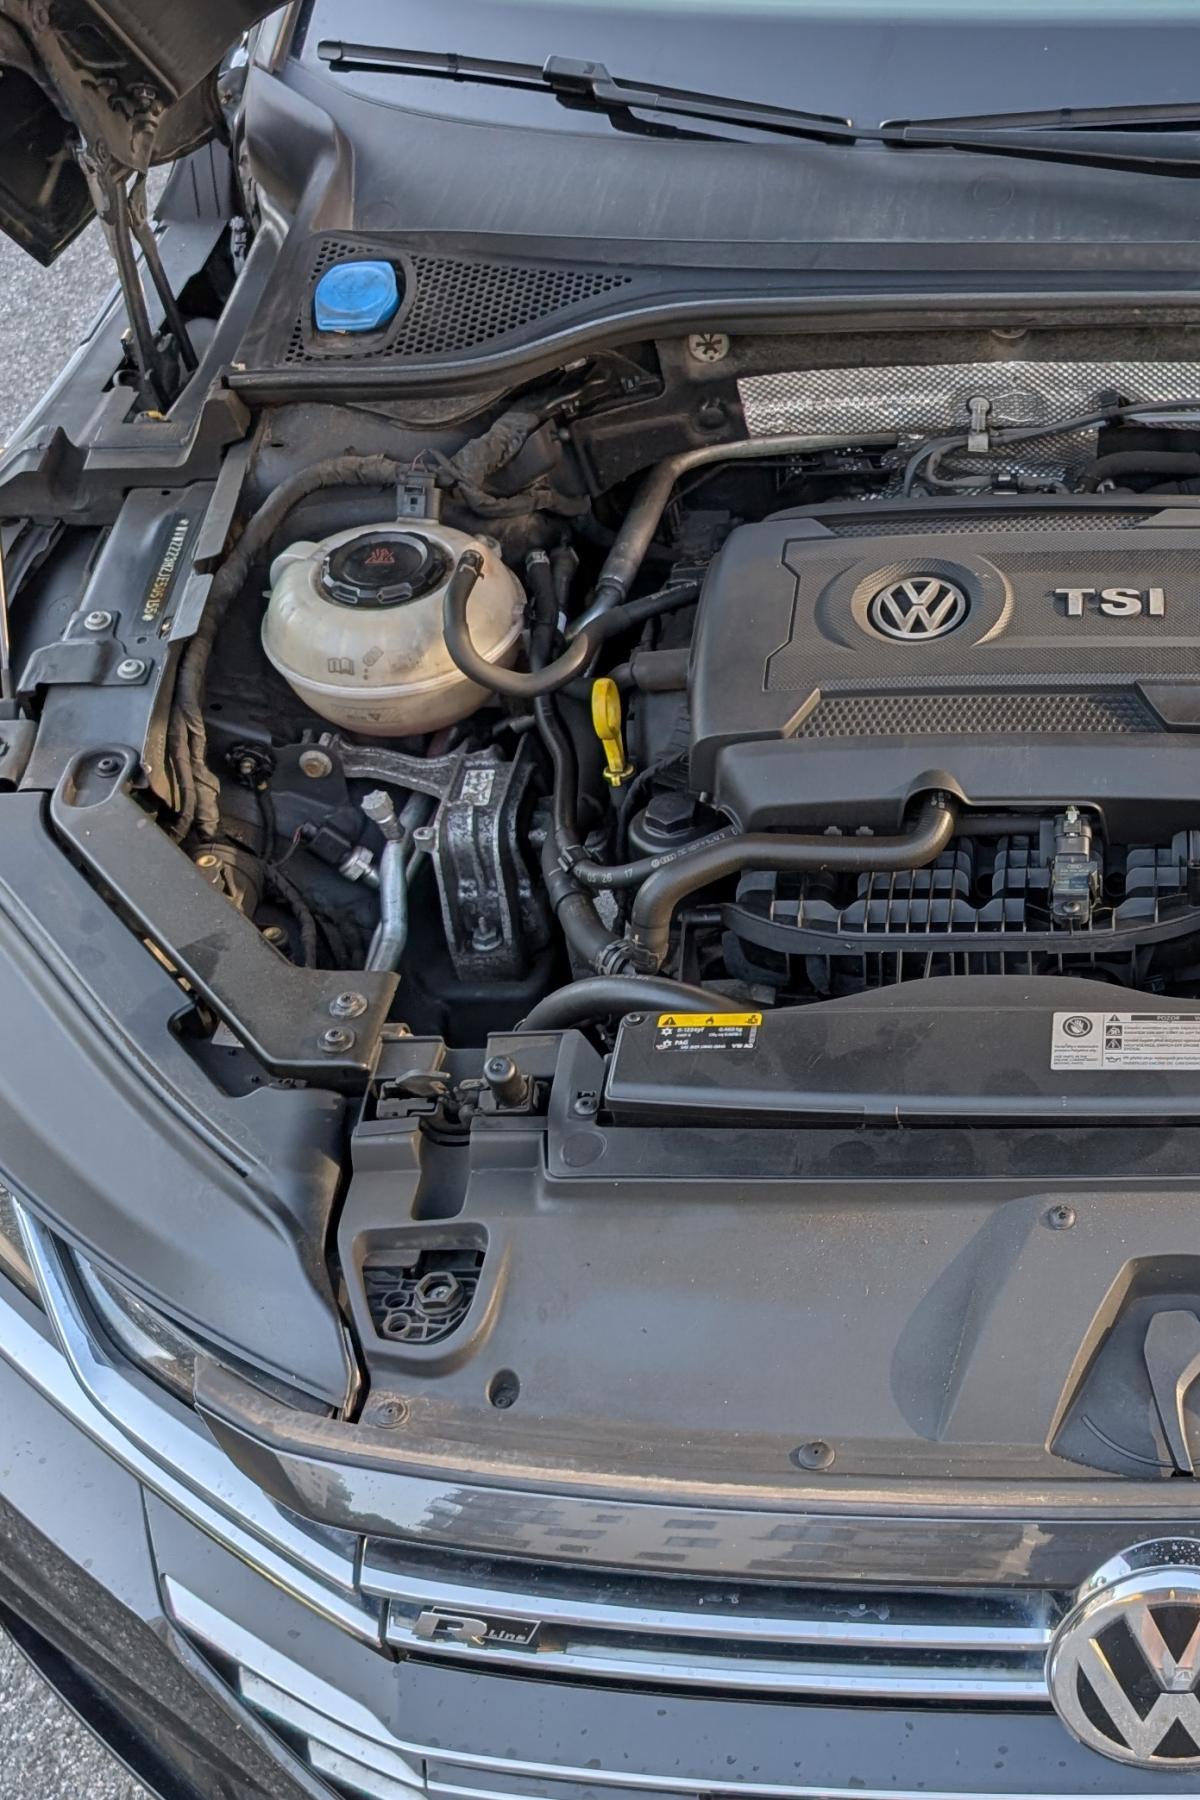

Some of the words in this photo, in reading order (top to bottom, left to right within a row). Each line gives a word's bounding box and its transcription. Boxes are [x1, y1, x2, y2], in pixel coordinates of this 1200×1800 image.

[874, 578, 965, 638] VW
[1055, 587, 1165, 618] TSI
[414, 1611, 488, 1644] R
